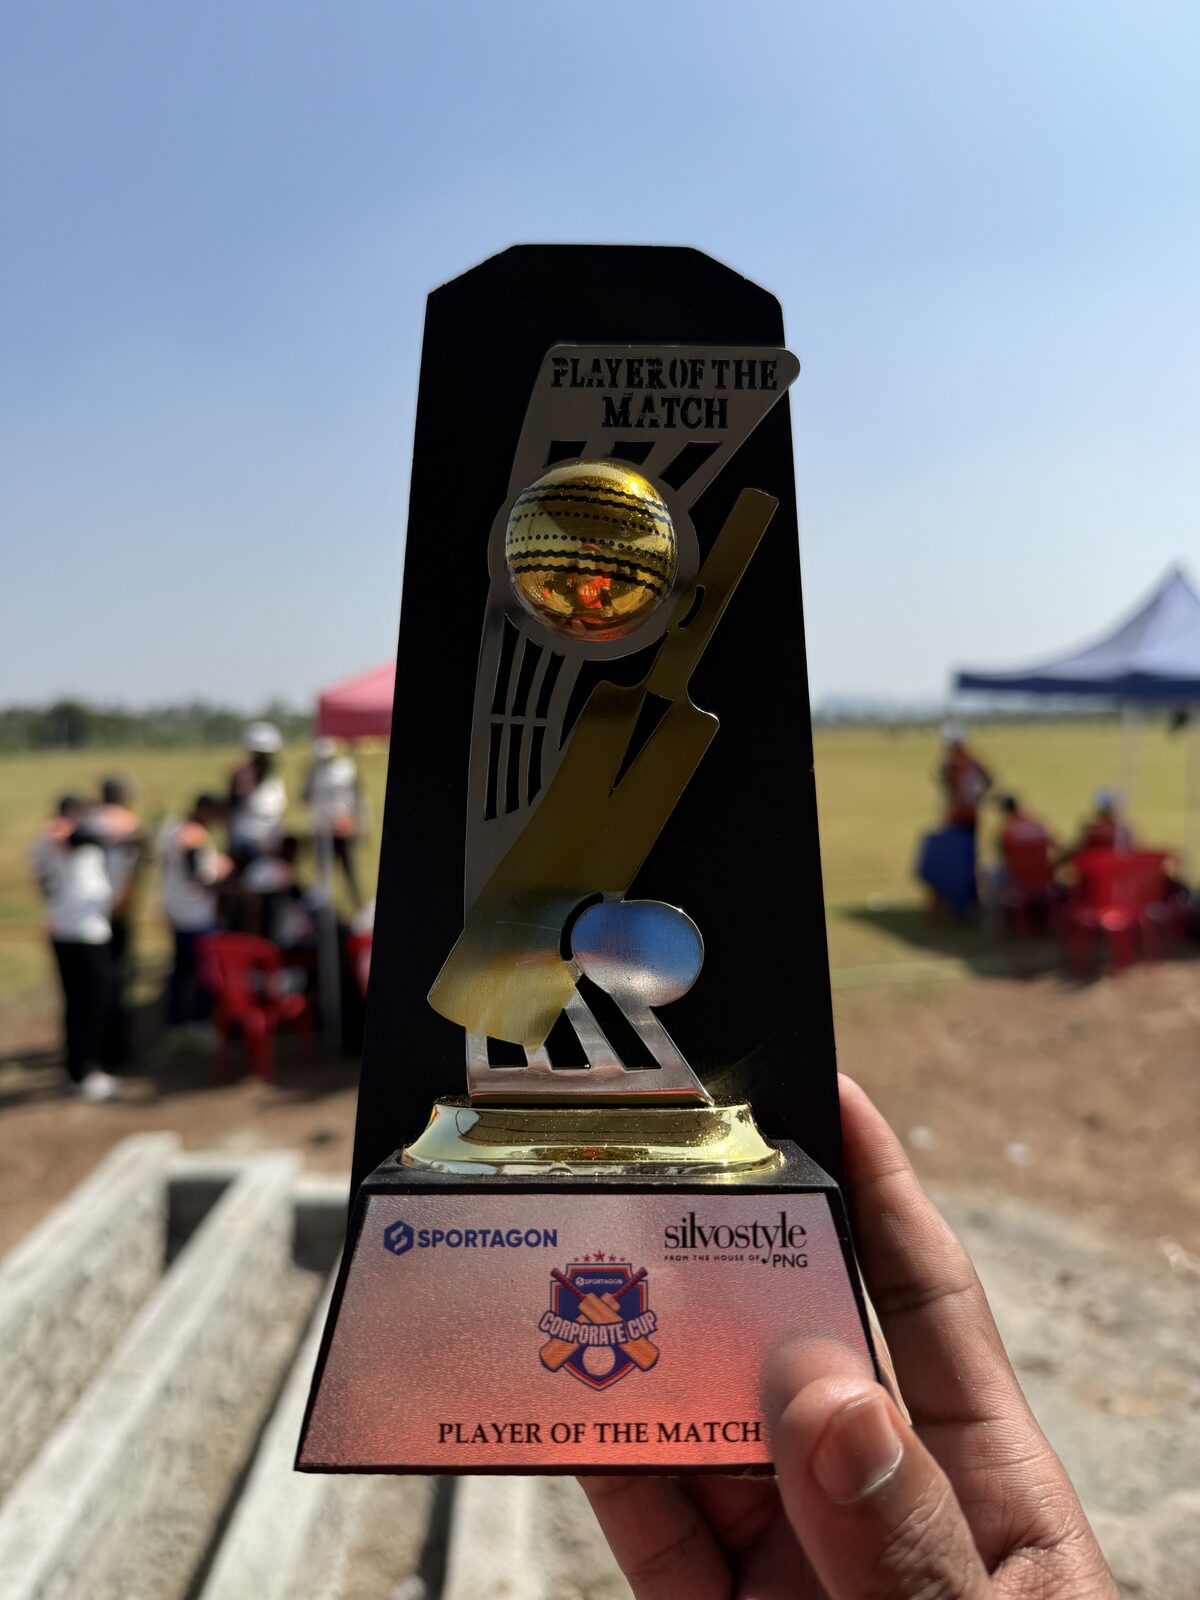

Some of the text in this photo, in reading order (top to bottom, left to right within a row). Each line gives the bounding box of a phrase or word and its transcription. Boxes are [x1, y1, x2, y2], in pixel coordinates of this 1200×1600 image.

[551, 357, 778, 391] PLAYER OF THE
[602, 393, 729, 429] MATCH
[417, 1228, 558, 1248] SPORTAGON
[664, 1211, 808, 1264] silvostyle
[714, 1254, 744, 1262] HOUSE
[772, 1253, 808, 1268] PNG
[539, 1310, 657, 1345] CORPORATE CUP
[438, 1421, 762, 1444] PLAYER OF THE MATCH
